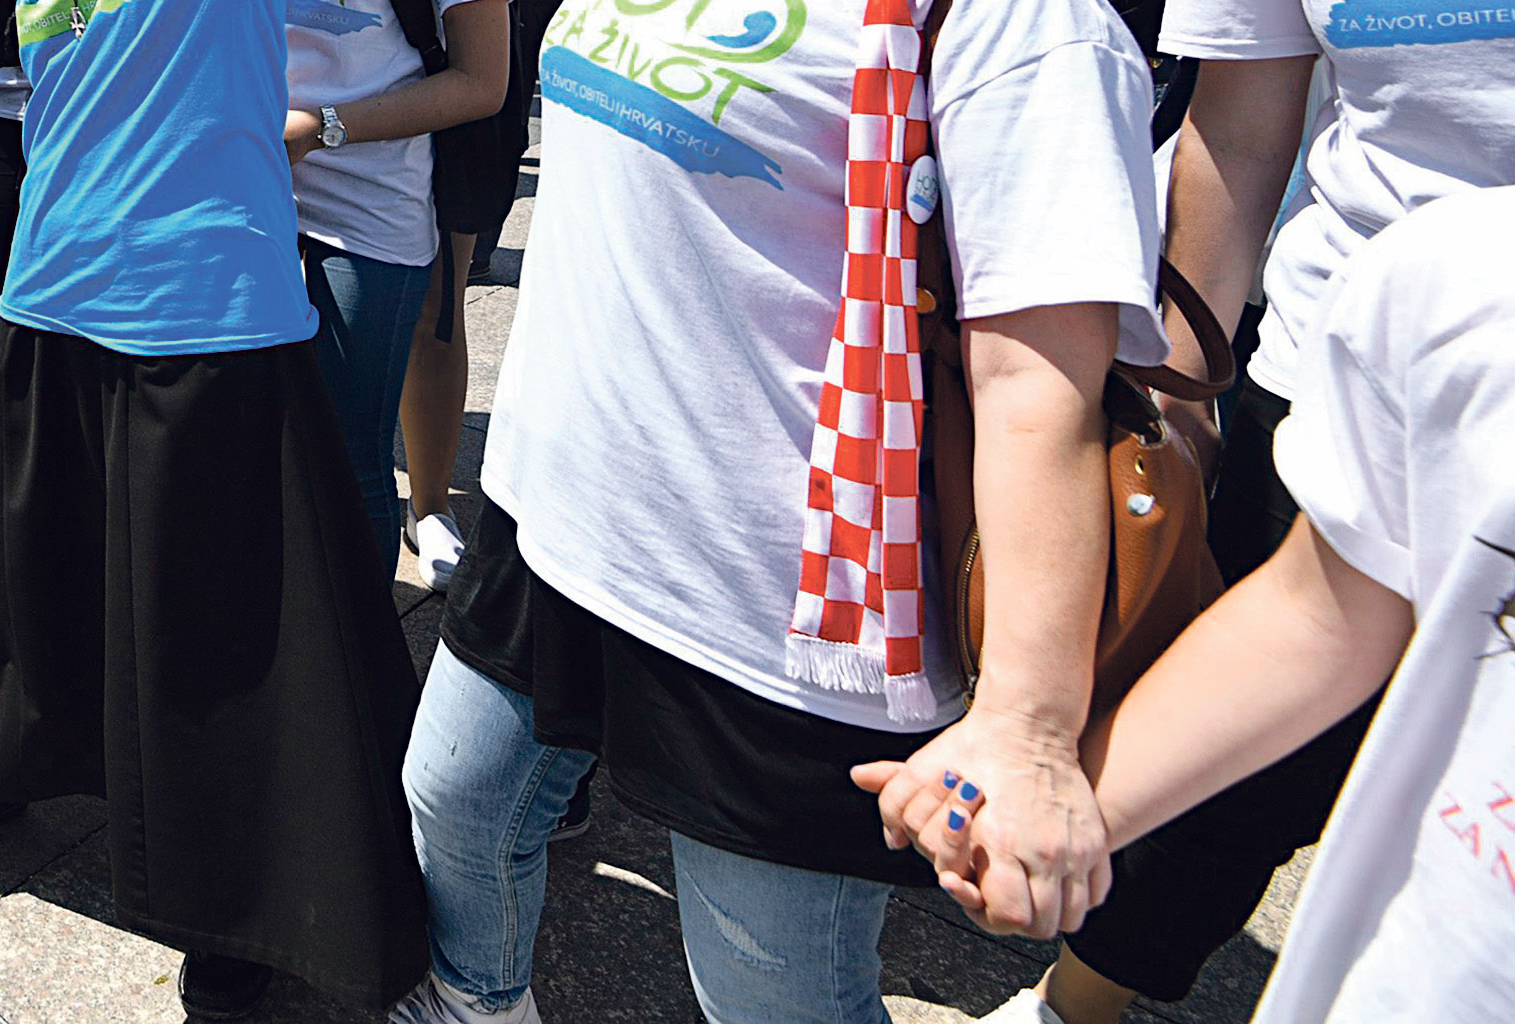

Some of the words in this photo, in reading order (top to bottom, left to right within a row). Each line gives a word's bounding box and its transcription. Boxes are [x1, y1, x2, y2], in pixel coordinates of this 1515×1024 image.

[1340, 18, 1362, 33] ZA
[1365, 10, 1433, 32] ŽIVOT,
[588, 17, 782, 126] ŽIVOT
[621, 102, 721, 159] HRVATSKU
